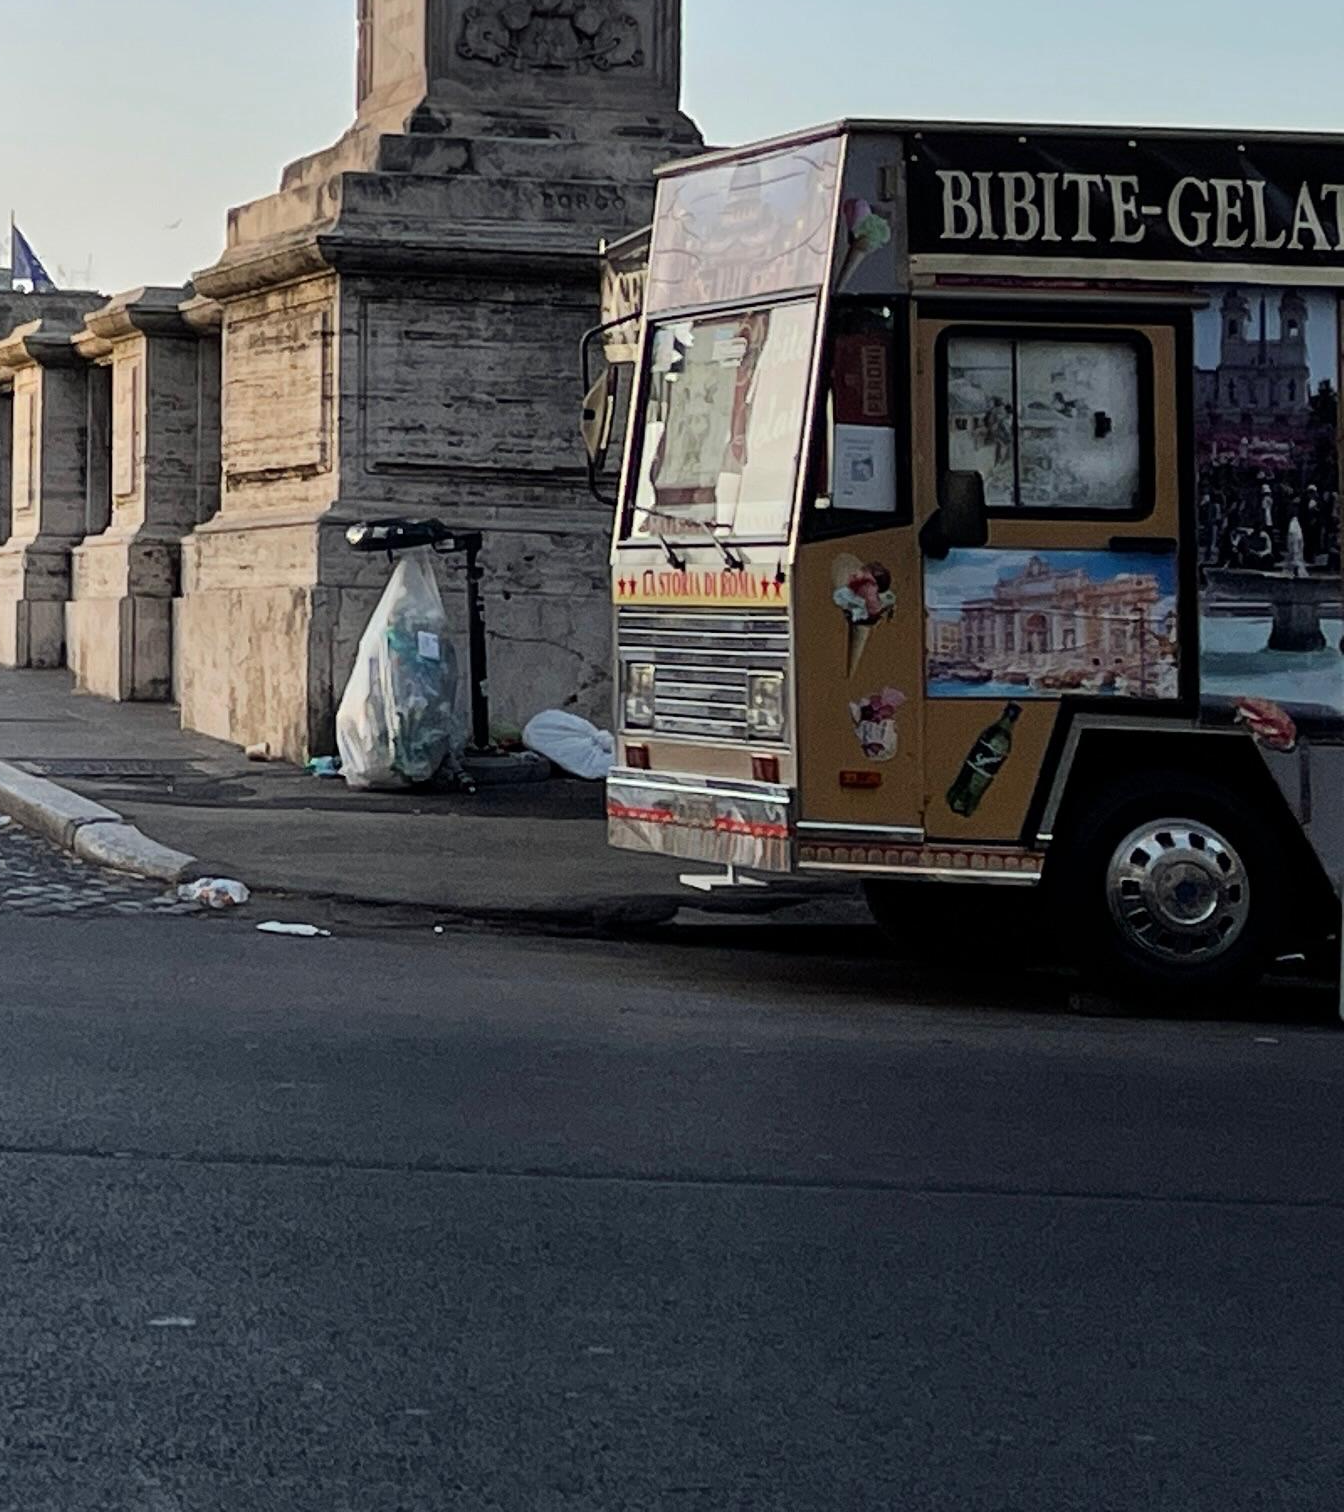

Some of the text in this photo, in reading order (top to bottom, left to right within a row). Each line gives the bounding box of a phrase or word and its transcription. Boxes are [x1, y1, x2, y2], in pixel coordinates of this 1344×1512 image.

[658, 572, 701, 598] STORIA
[704, 572, 717, 597] DI
[720, 569, 758, 598] ROMA
